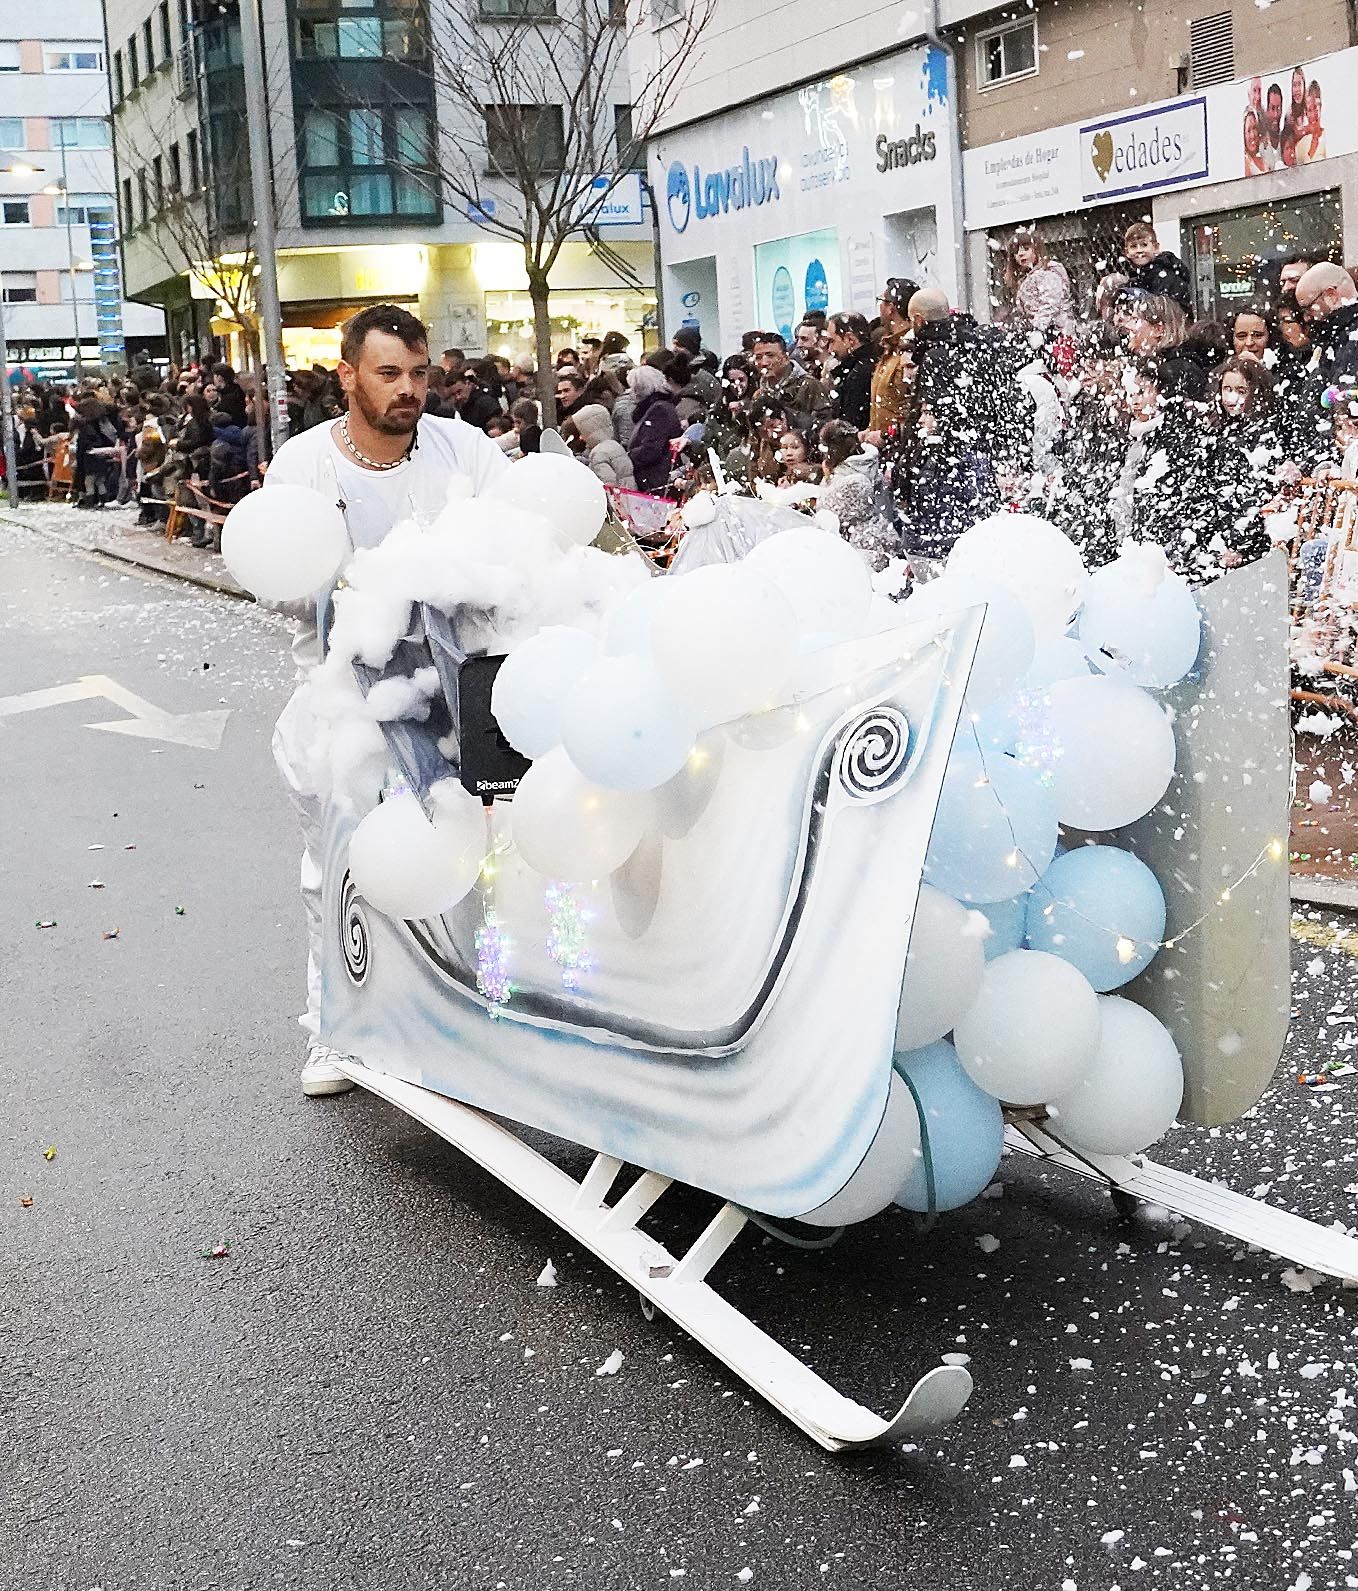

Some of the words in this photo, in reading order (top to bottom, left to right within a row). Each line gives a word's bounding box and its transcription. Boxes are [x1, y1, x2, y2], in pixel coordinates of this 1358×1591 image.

[876, 123, 937, 173] Snacks
[1115, 126, 1182, 173] edades
[694, 146, 780, 219] Lavalux
